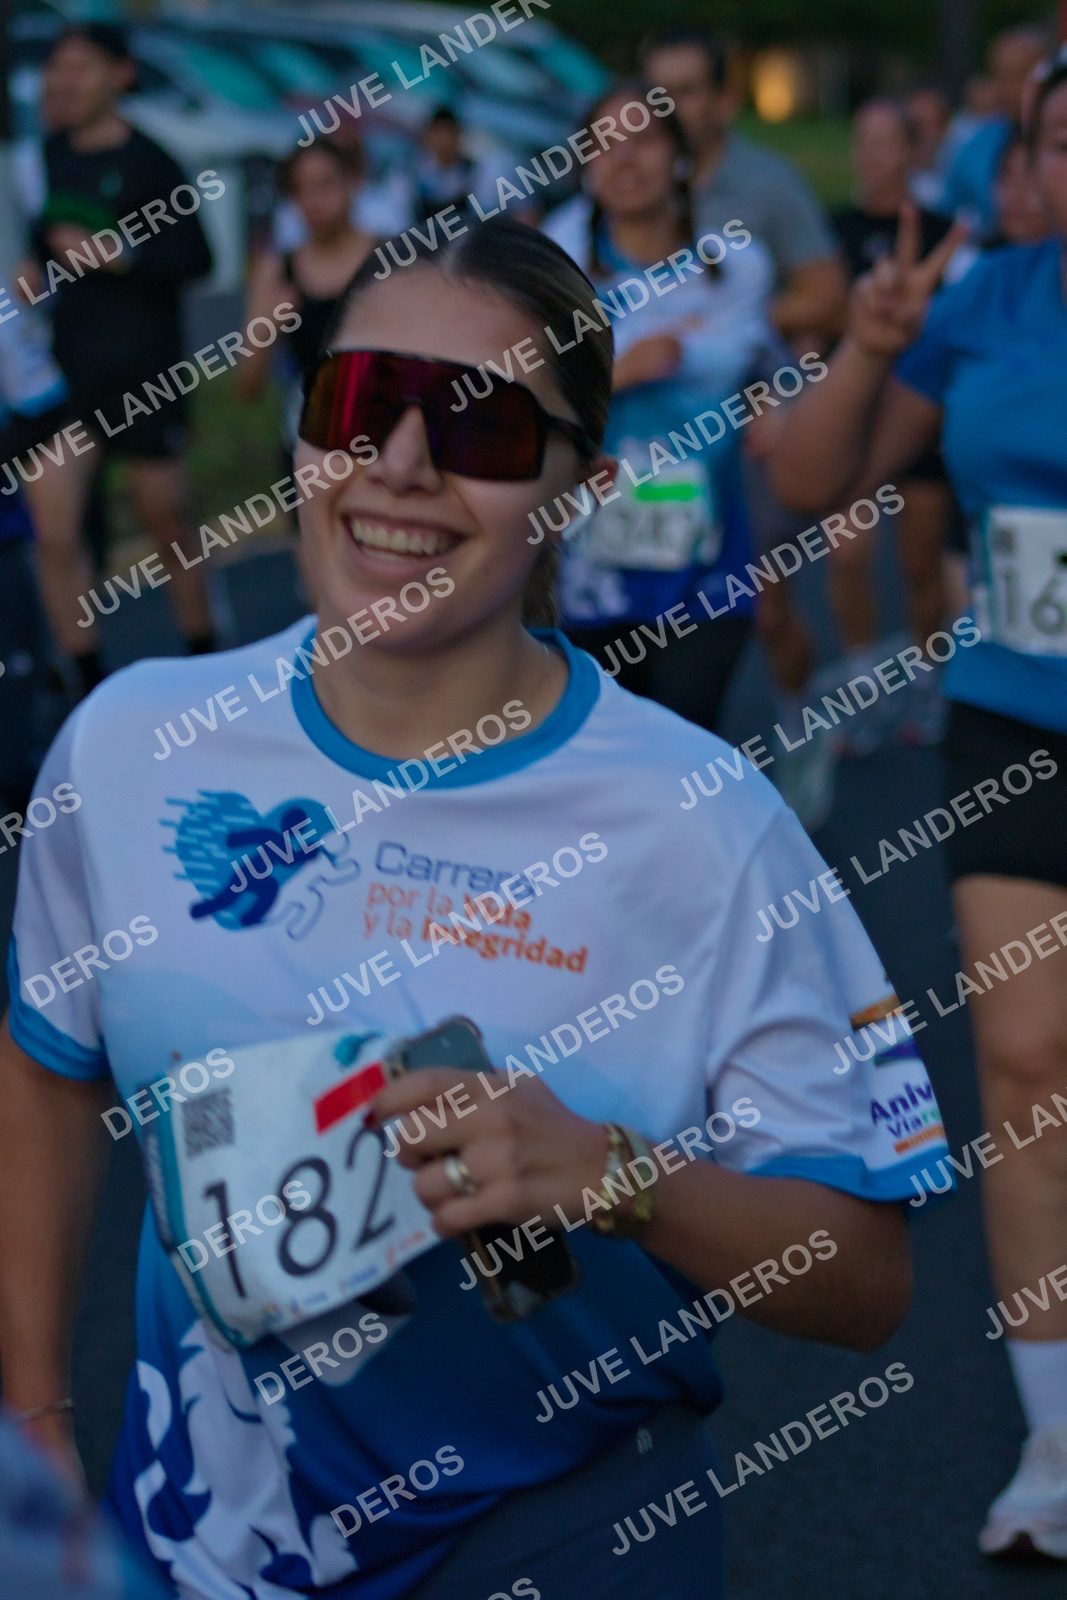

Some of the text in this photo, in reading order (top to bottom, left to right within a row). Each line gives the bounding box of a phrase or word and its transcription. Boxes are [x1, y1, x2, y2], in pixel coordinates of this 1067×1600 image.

[375, 841, 536, 900] Carrera
[367, 882, 420, 910] por
[427, 886, 453, 916] la
[363, 911, 379, 938] y
[386, 908, 412, 939] la
